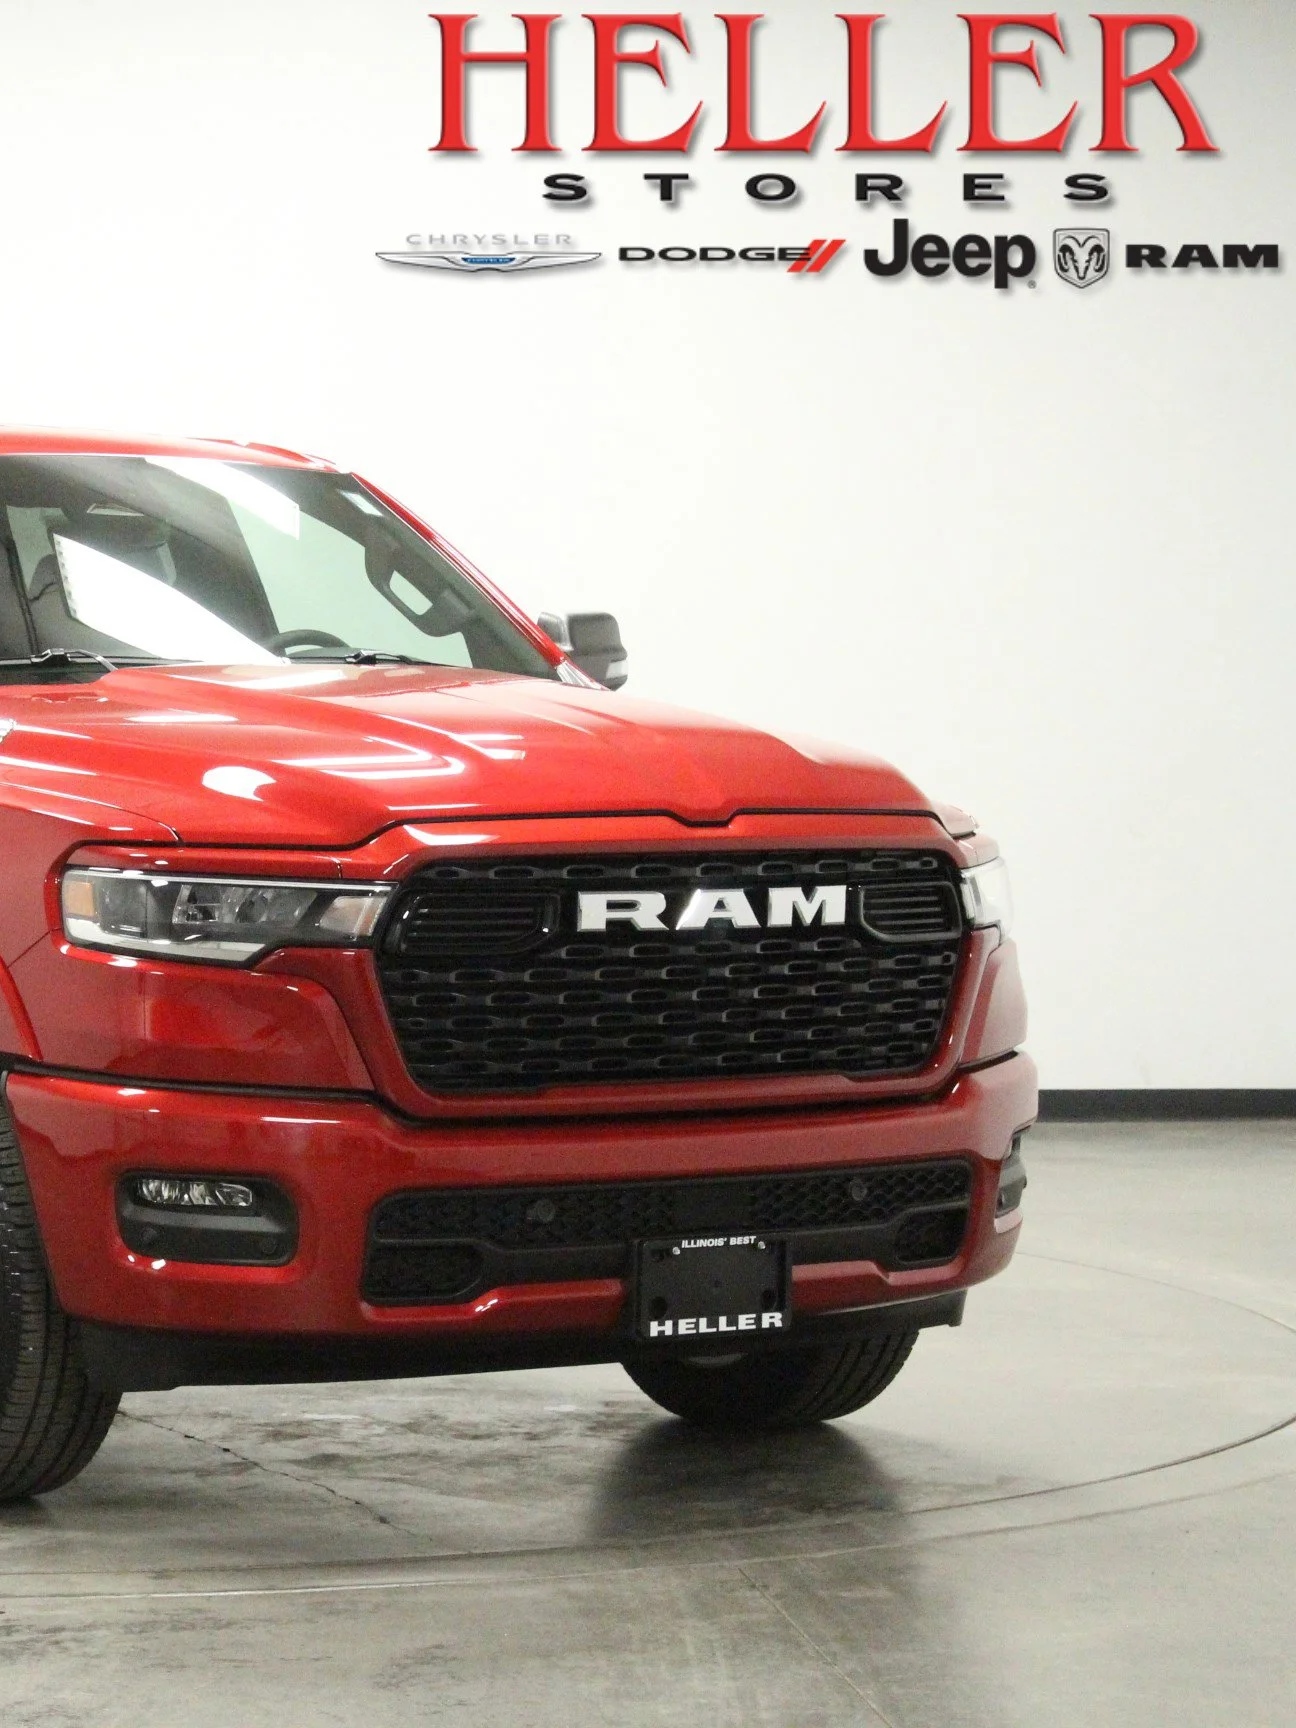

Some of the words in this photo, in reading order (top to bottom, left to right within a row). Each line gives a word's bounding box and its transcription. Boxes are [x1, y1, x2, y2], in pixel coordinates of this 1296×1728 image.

[577, 885, 847, 932] RAM
[729, 1235, 757, 1245] BEST
[649, 1311, 783, 1337] HELLER
